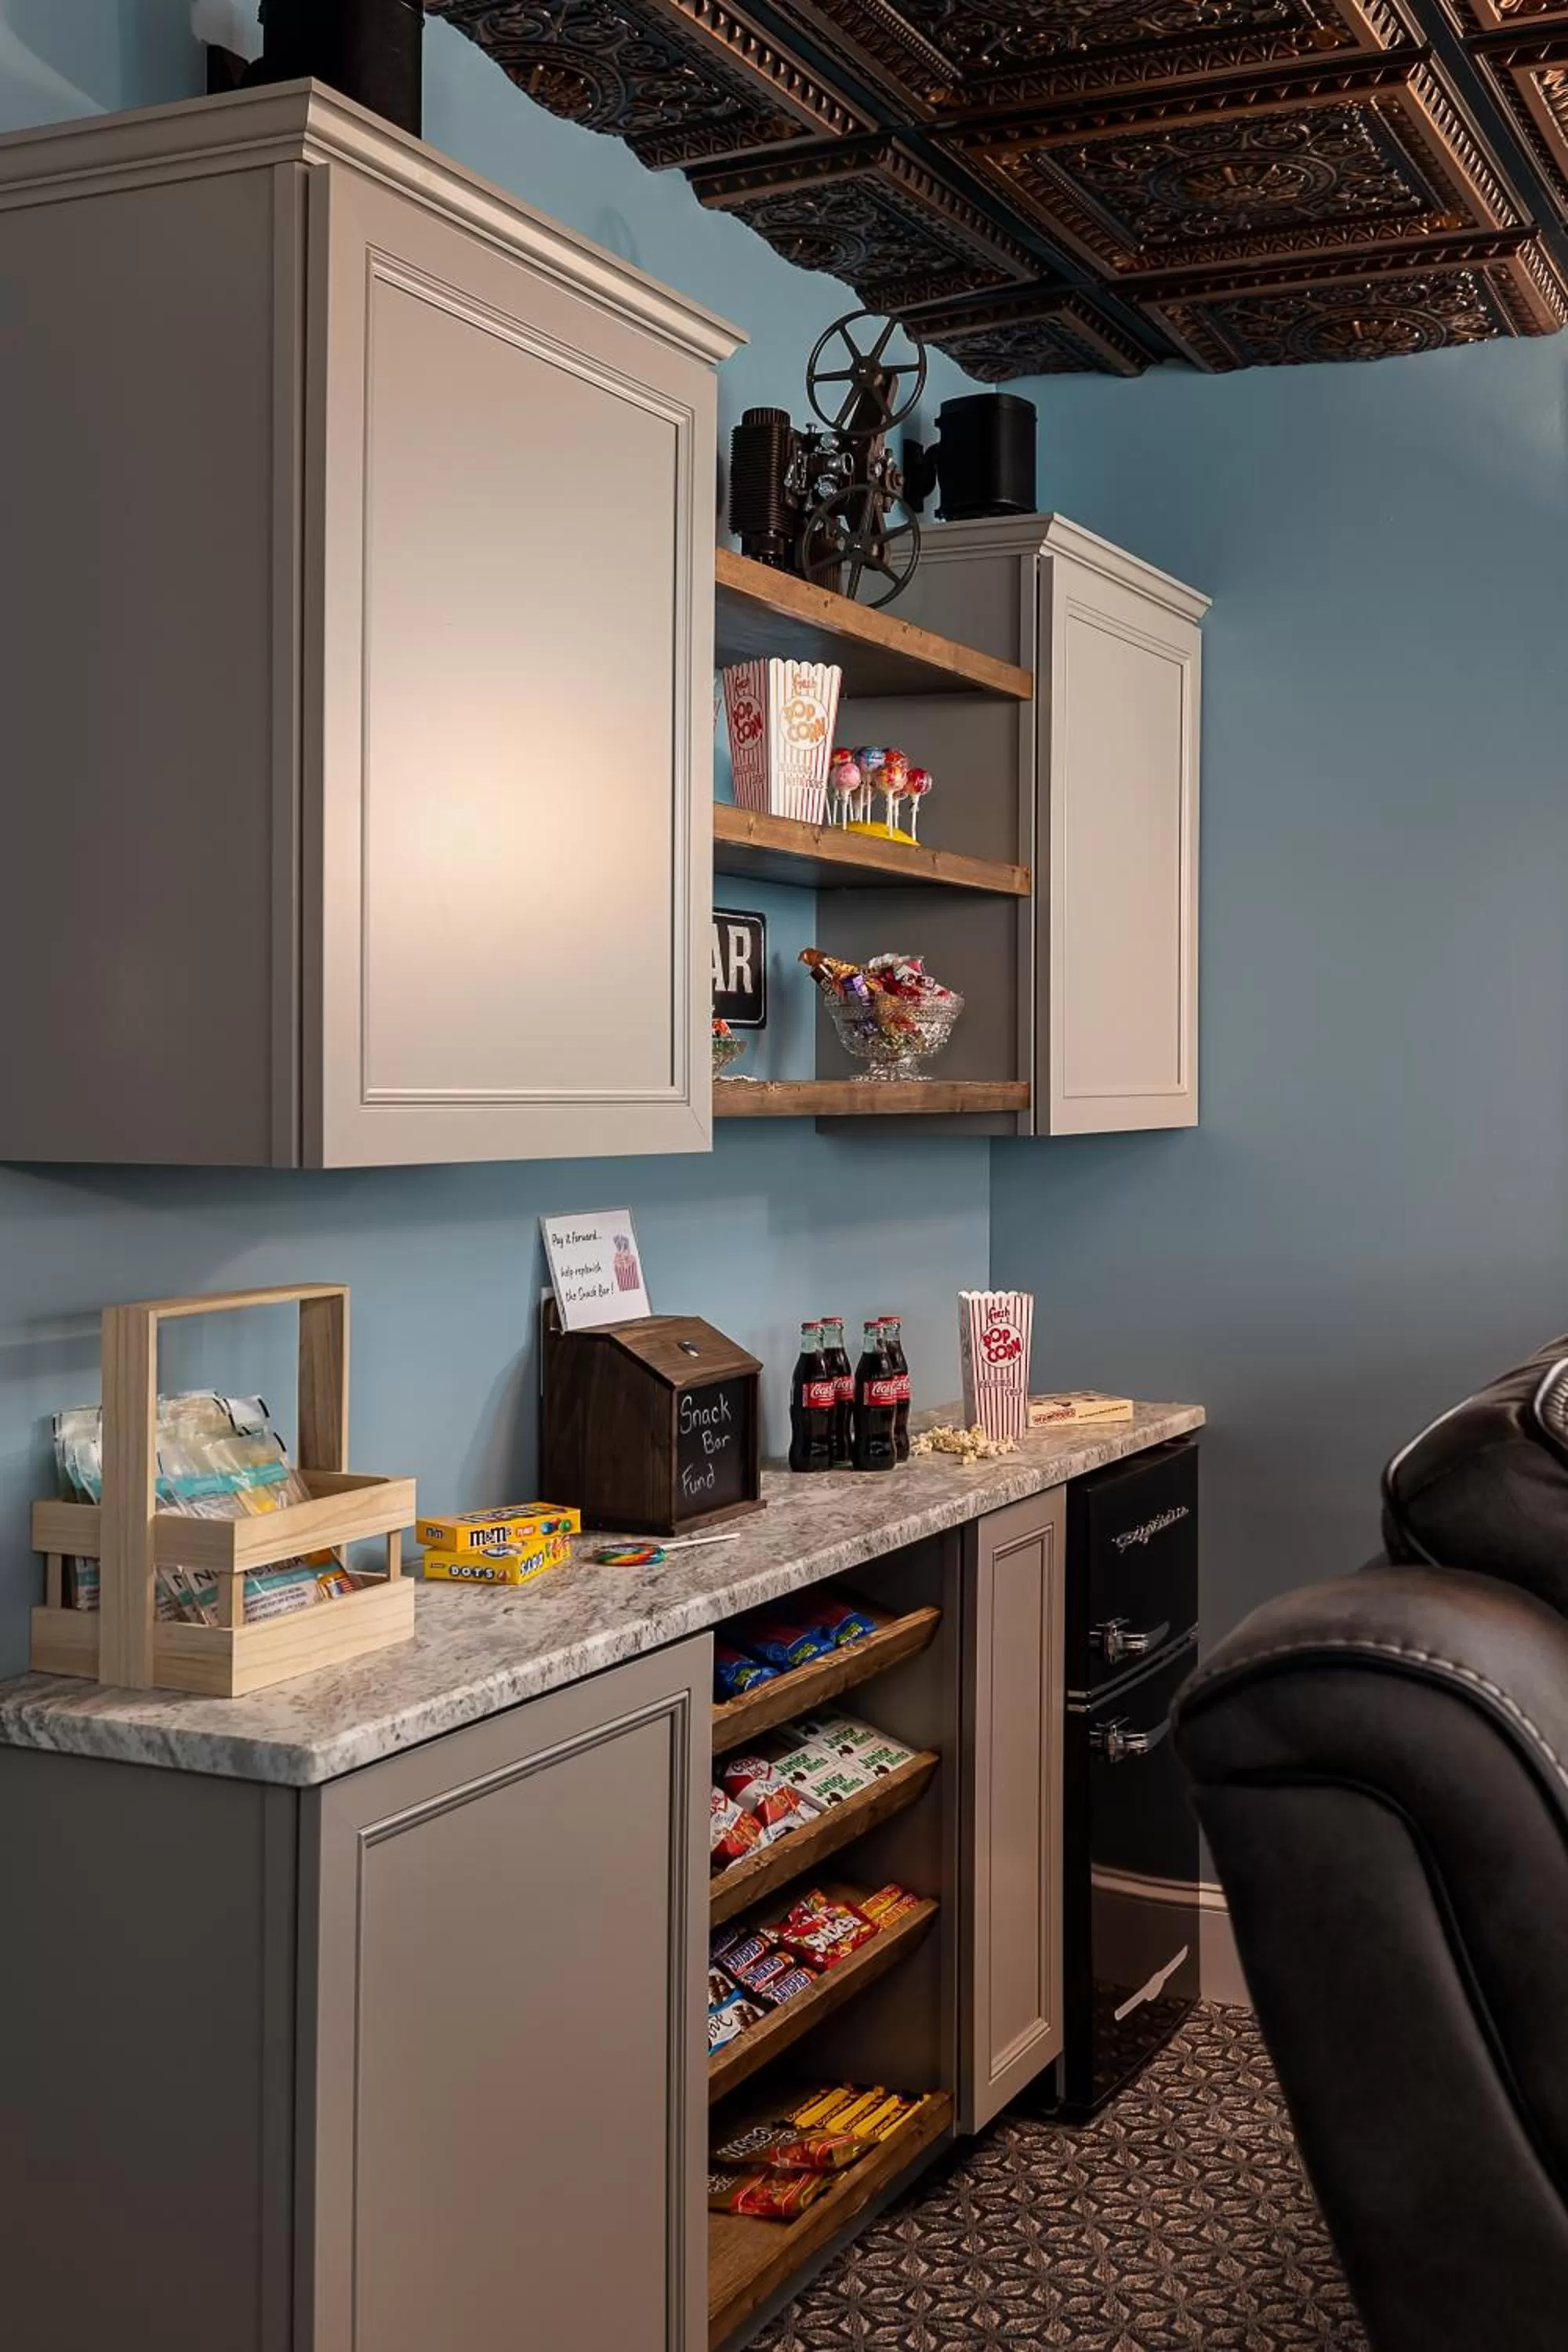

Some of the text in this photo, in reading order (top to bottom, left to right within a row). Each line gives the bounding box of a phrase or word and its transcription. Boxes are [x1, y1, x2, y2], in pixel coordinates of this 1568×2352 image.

[680, 1392, 731, 1434] Snack
[702, 1430, 731, 1454] Bar
[681, 1462, 716, 1500] Fund
[450, 1566, 494, 1579] DOTS
